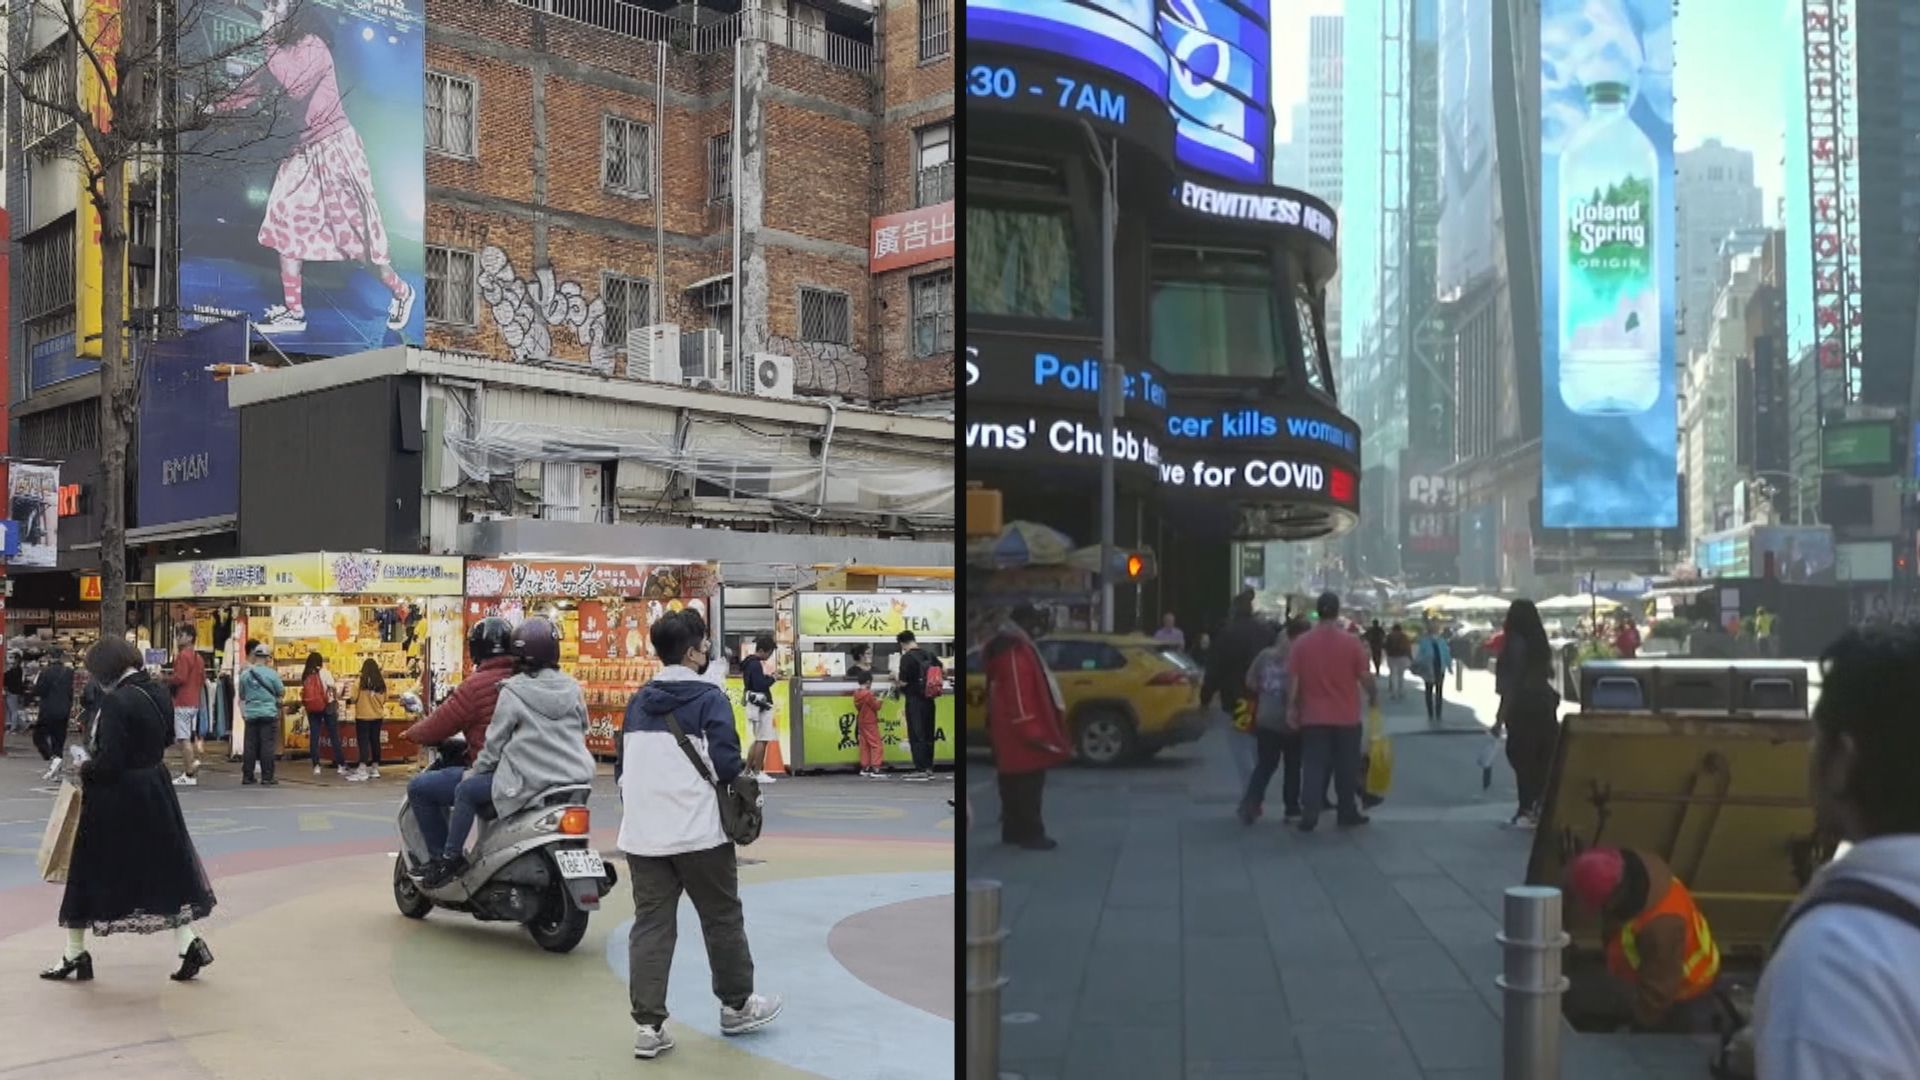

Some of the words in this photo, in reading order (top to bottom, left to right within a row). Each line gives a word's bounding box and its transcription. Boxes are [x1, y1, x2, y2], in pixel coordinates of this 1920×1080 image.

[966, 65, 1017, 99] 30
[1056, 77, 1125, 123] 7AM
[1181, 180, 1302, 226] EYEWITNESS
[1572, 200, 1641, 233] Poland
[1580, 221, 1646, 254] Spring
[1577, 257, 1641, 269] ORIGIN
[1034, 353, 1135, 397] Polie:
[1222, 409, 1277, 437] kills
[1193, 460, 1236, 488] for
[1244, 459, 1324, 491] COVID
[902, 616, 931, 632] TEA
